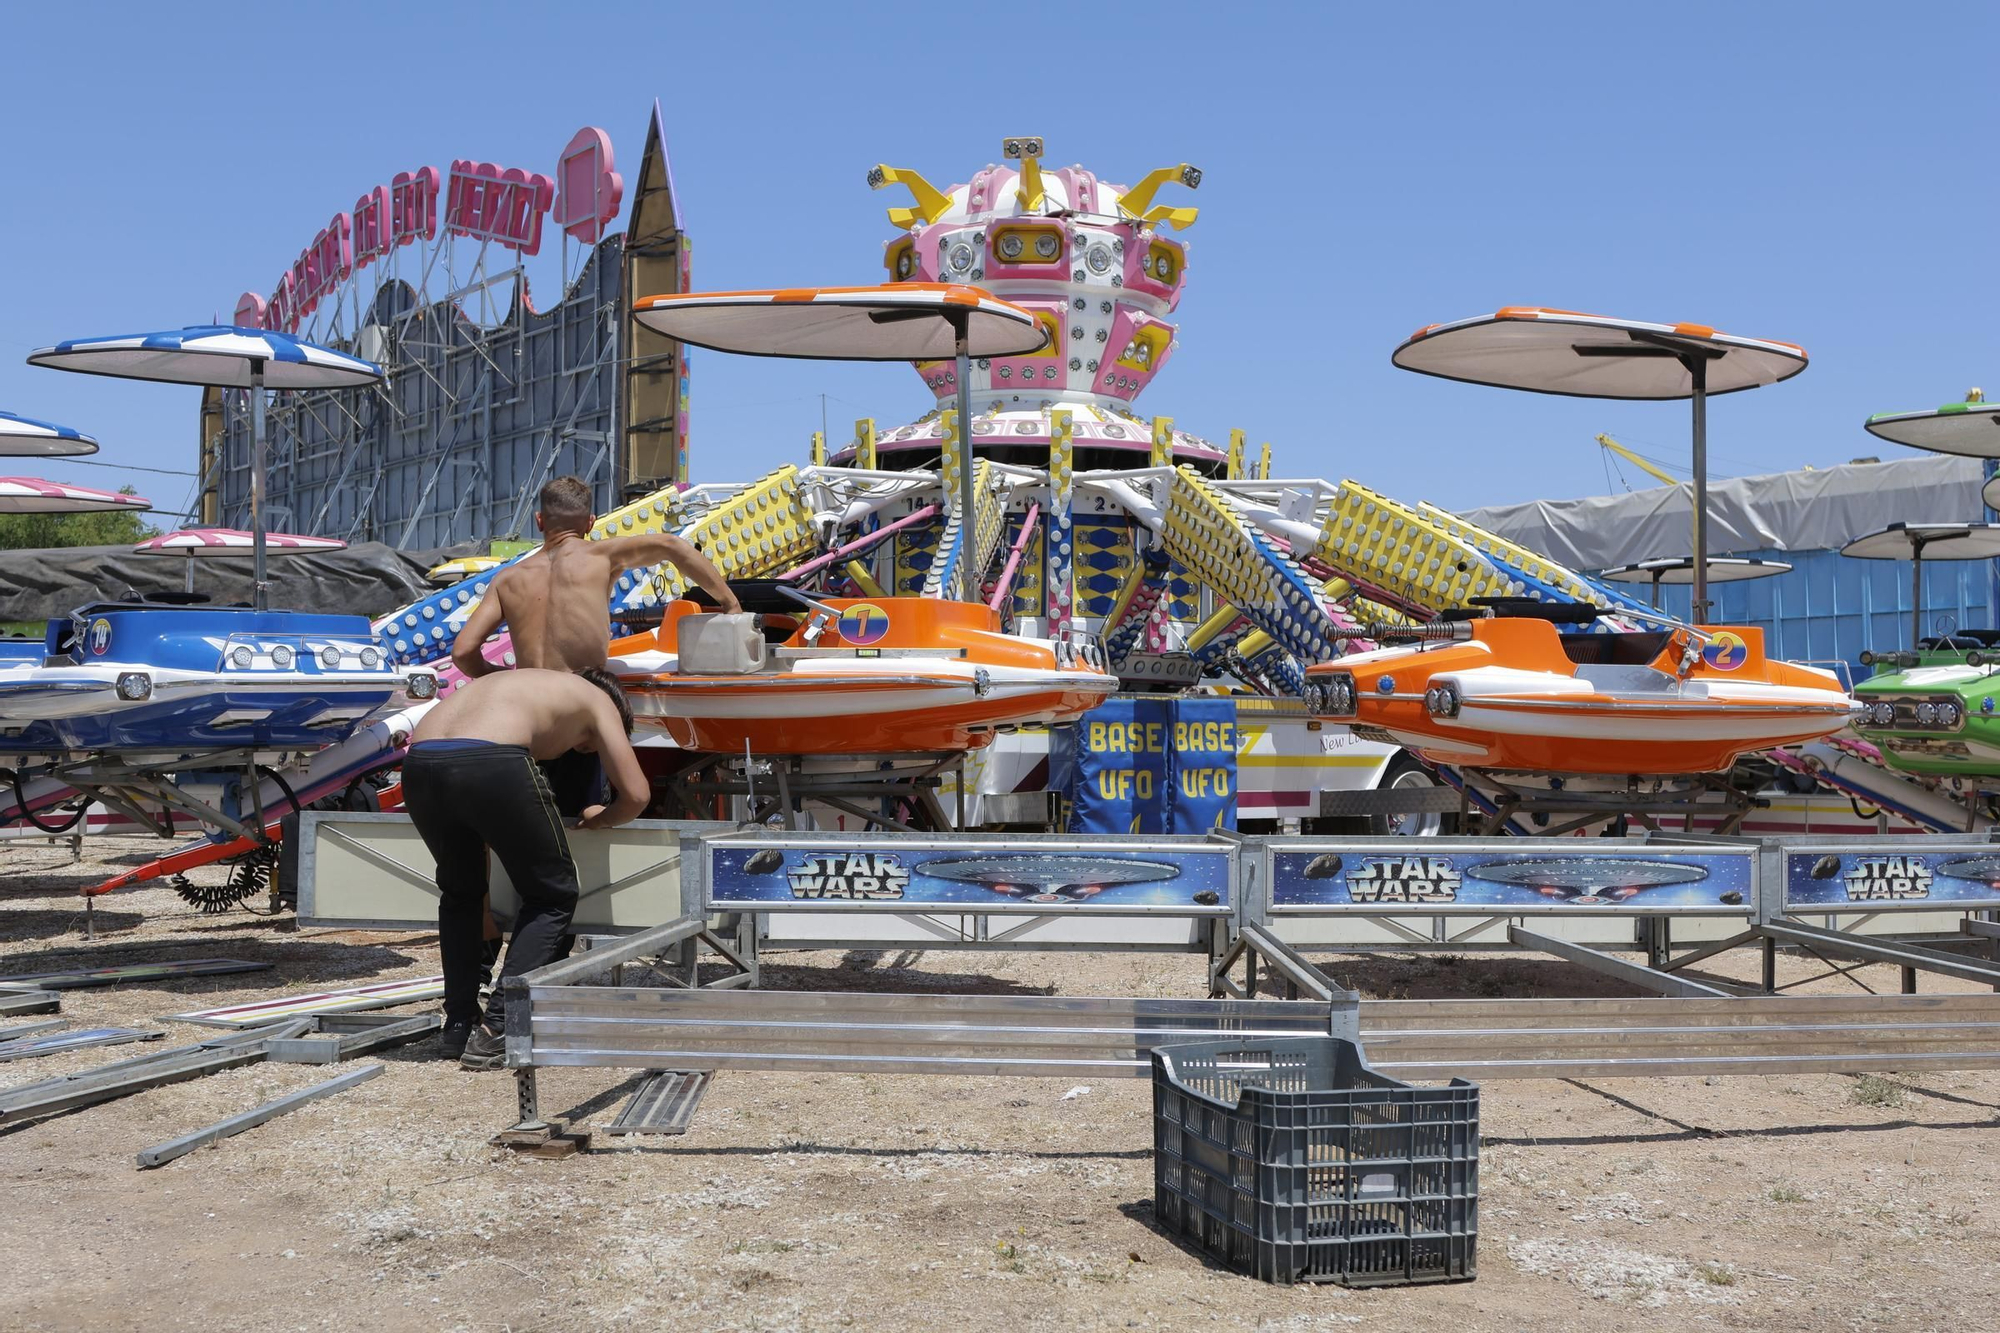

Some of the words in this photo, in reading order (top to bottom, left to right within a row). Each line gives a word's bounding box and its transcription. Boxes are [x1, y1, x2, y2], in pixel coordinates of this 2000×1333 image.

[1095, 496, 1105, 512] 2
[856, 609, 870, 638] 1
[95, 624, 107, 649] 14
[1716, 636, 1735, 664] 2
[1090, 722, 1163, 752] BASE
[1174, 722, 1235, 752] BASE
[1320, 736, 1344, 753] New
[1099, 769, 1153, 800] UFO
[1182, 768, 1229, 798] UFO
[787, 852, 909, 876] STAR
[1346, 857, 1461, 880] STAR
[1844, 856, 1933, 878] STAR
[787, 875, 909, 899] WARS
[1347, 880, 1461, 902] WARS
[1844, 878, 1933, 900] WARS
